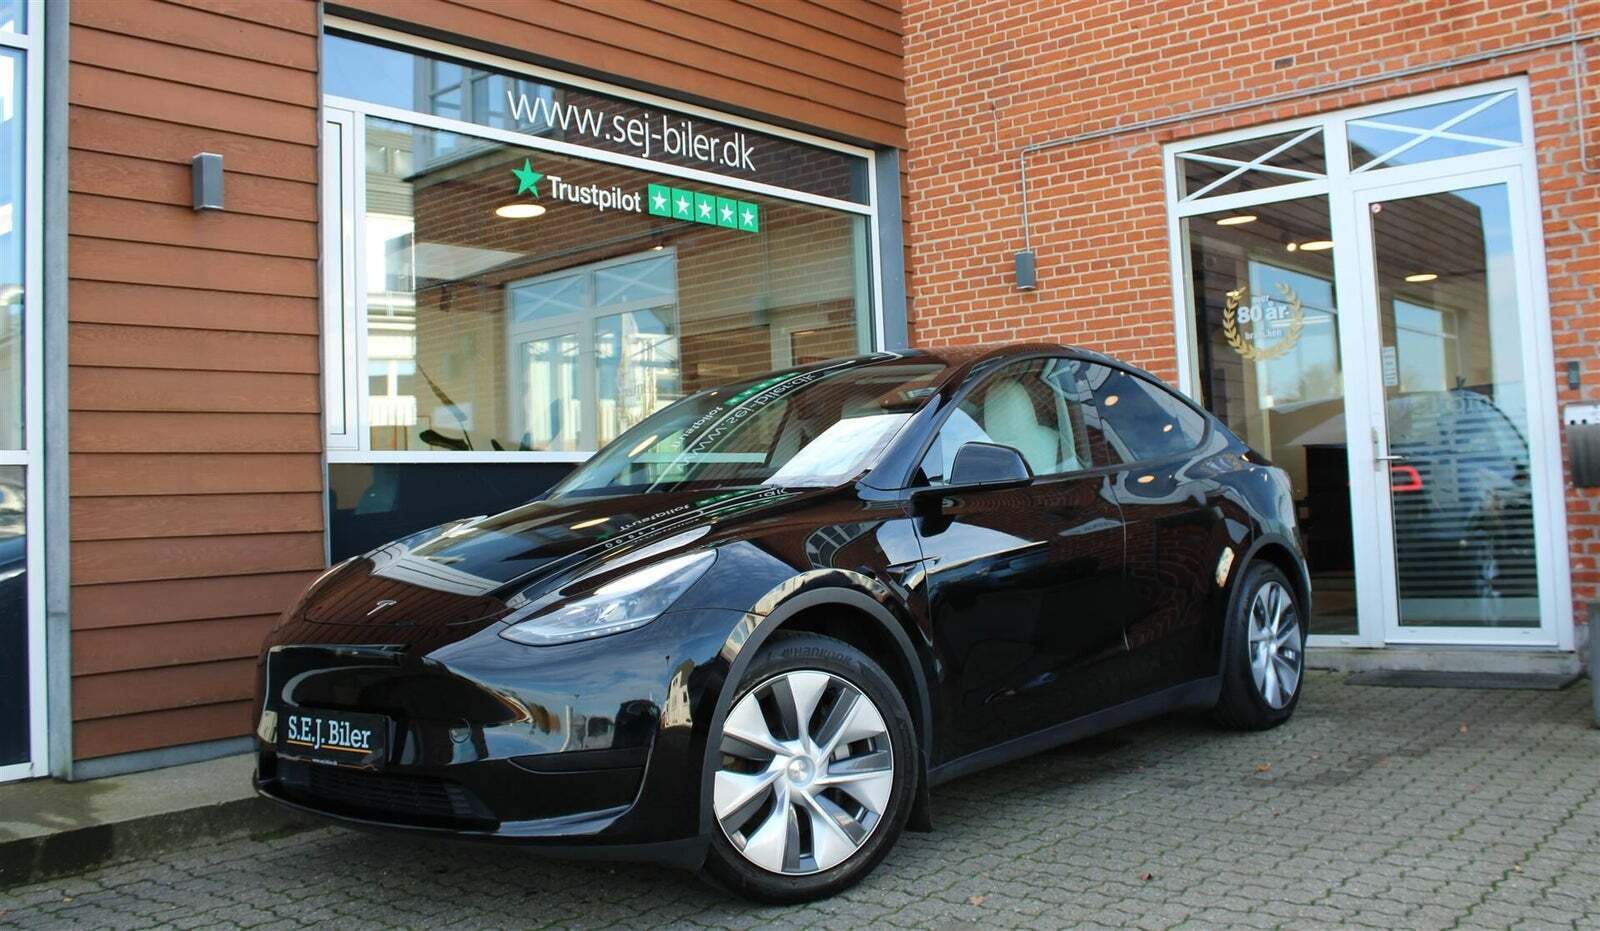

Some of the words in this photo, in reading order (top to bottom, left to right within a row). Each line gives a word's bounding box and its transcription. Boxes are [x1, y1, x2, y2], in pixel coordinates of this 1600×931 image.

[507, 90, 756, 171] www.sej-biler.dk
[547, 175, 642, 213] Trustpilot
[1237, 305, 1262, 324] 80
[288, 715, 325, 750] S.E.J.
[328, 720, 371, 748] Biler
